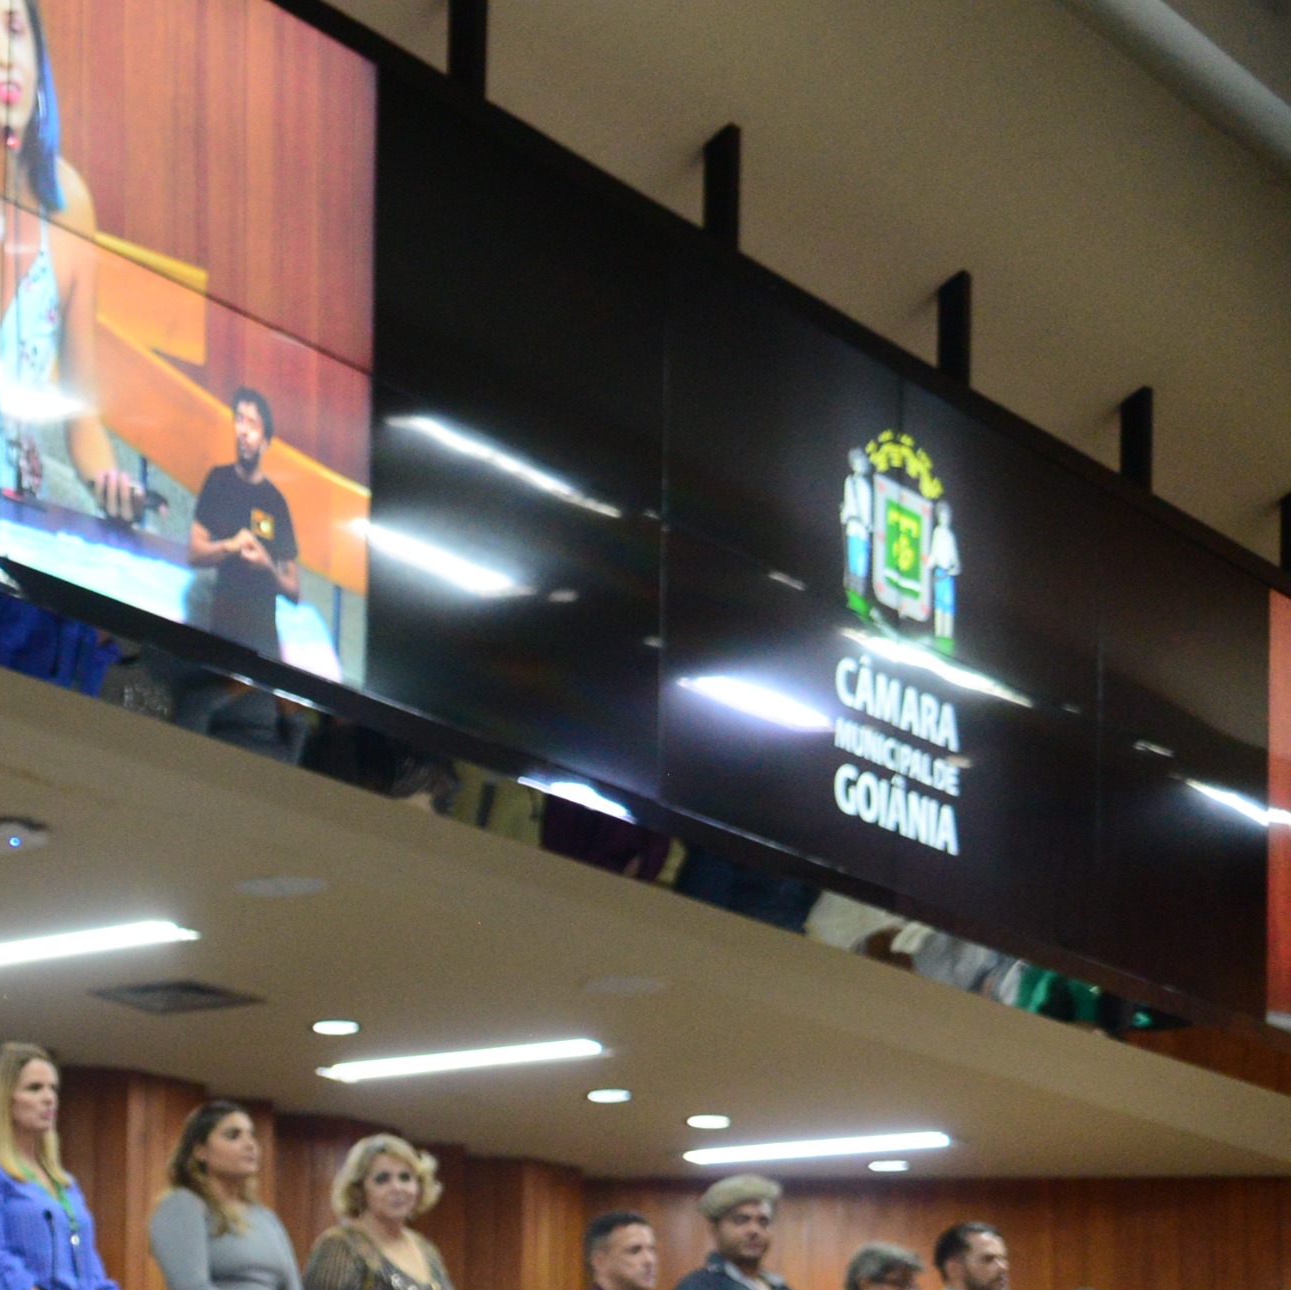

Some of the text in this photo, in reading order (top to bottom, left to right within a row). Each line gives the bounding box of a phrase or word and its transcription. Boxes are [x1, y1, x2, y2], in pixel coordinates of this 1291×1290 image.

[835, 654, 959, 752] CÂMARA
[834, 717, 960, 797] MUNICIPAL DE
[834, 763, 959, 857] GOIÂNIA
